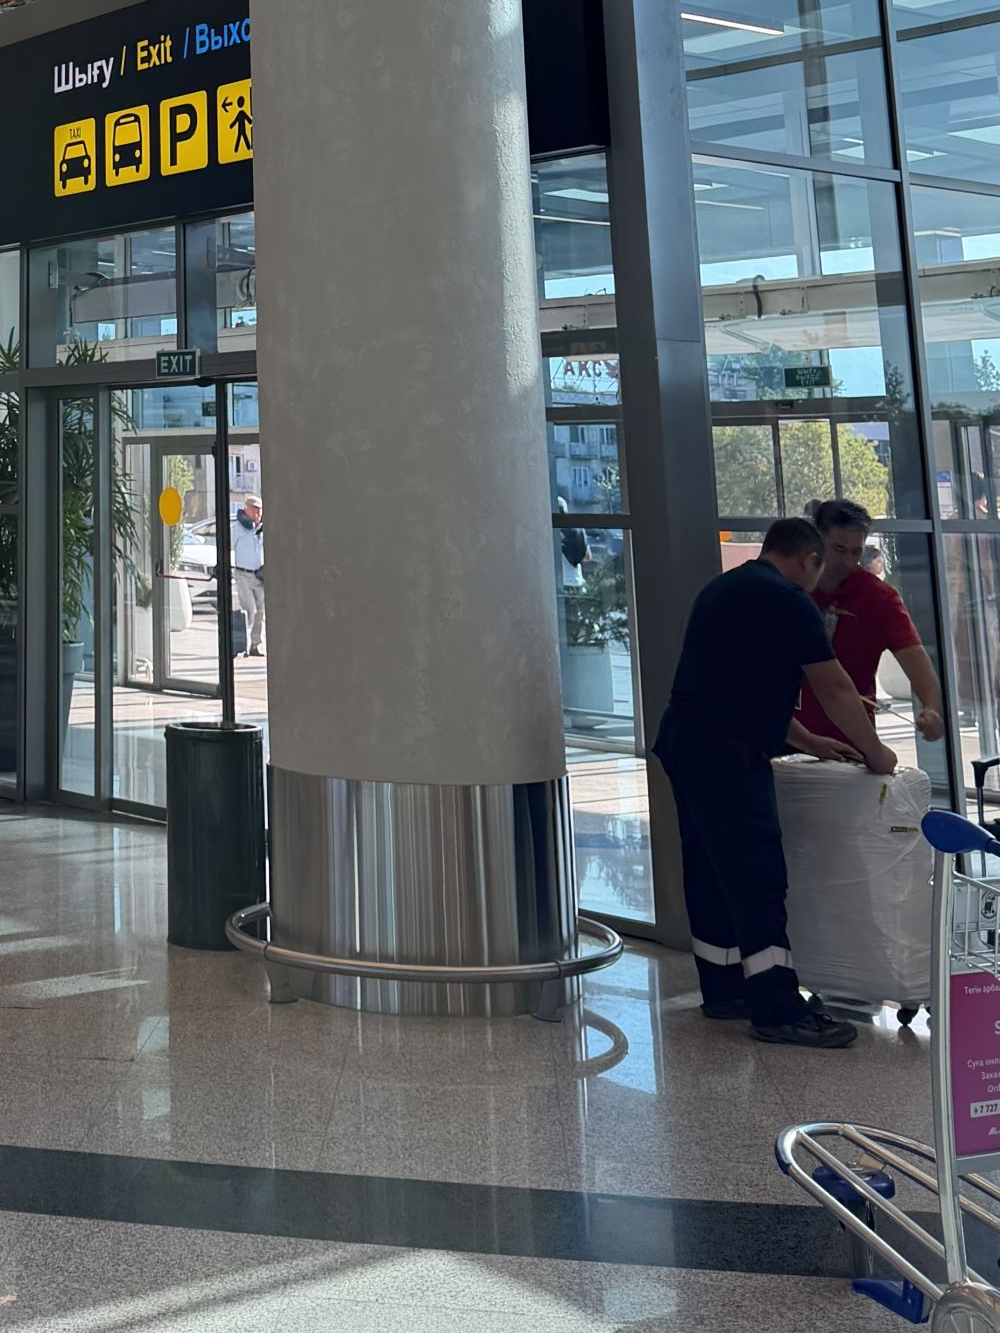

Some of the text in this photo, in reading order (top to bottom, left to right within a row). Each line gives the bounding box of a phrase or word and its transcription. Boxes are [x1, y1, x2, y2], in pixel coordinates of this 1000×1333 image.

[53, 56, 115, 94] Шығу
[136, 34, 173, 71] Exit
[69, 127, 82, 140] TAXI
[168, 103, 198, 166] P
[160, 355, 193, 374] EXIT
